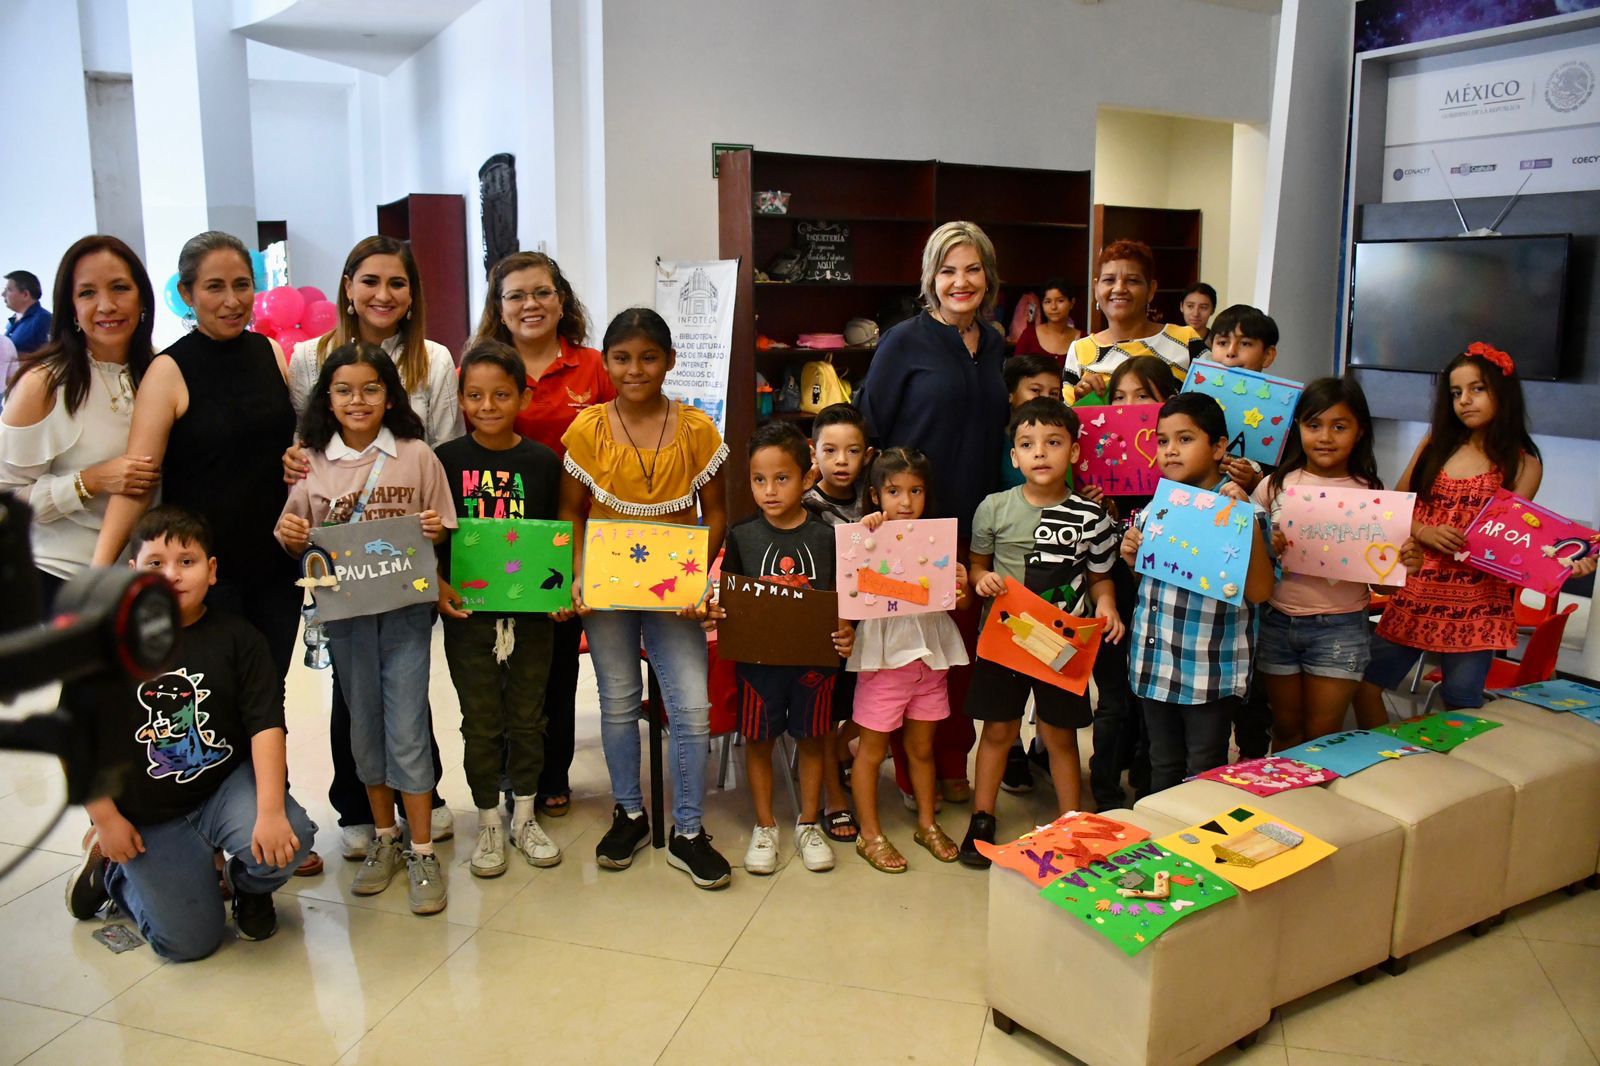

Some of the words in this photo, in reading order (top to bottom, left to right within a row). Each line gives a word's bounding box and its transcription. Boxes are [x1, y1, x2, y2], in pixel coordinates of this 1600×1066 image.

[1444, 79, 1521, 105] MÉXICO
[1404, 167, 1431, 176] CONACYT
[678, 316, 717, 324] INFOTECA
[696, 342, 722, 350] LECTURA
[697, 352, 725, 360] TRABAJO
[681, 361, 709, 369] INTERNET
[676, 370, 705, 378] MÓDULOS
[706, 371, 716, 379] DE
[462, 470, 525, 499] MAZA
[463, 498, 525, 519] TLAN
[1478, 519, 1532, 549] AROA
[335, 557, 413, 582] PAULINA
[726, 574, 804, 599] NATHAN
